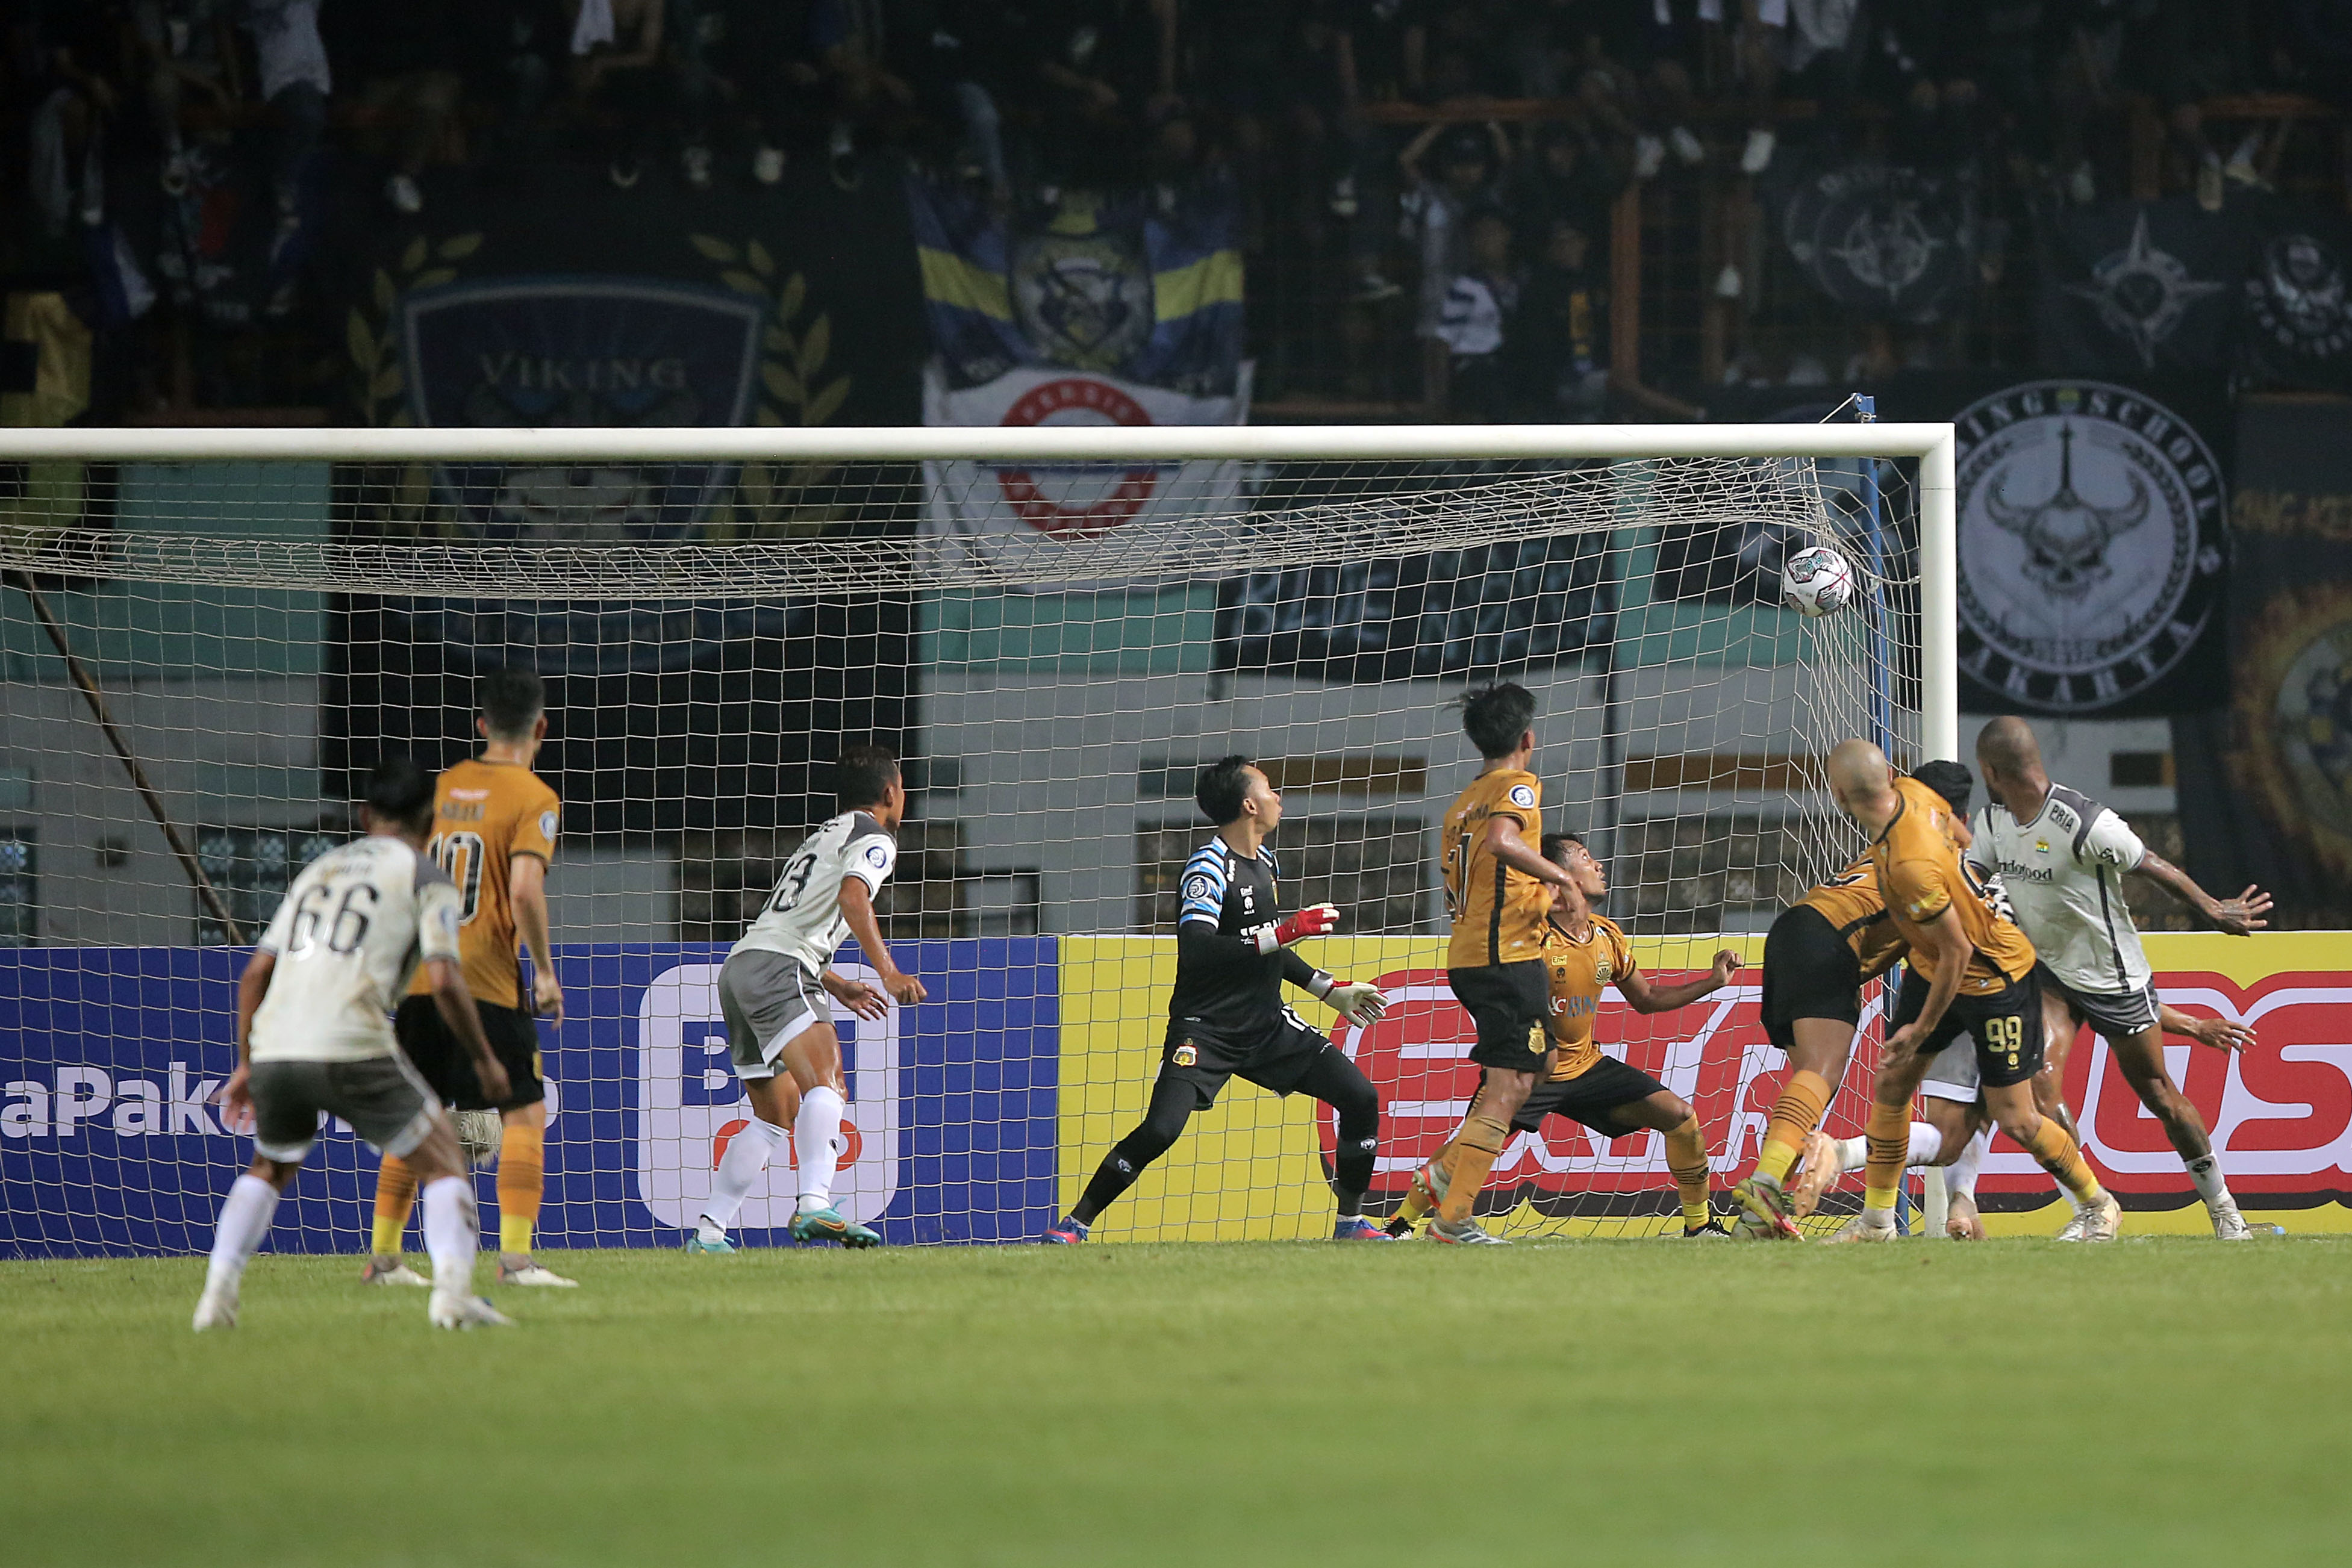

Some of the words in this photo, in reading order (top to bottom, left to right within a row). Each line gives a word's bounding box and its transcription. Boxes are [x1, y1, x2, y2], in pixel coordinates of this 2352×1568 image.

[480, 353, 686, 390] VIKING
[2090, 391, 2219, 519] SCHOOL
[1957, 621, 2199, 703] AKARTA
[1995, 860, 2053, 882] ndofood
[289, 883, 379, 954] 66
[1985, 1015, 2023, 1053] 99
